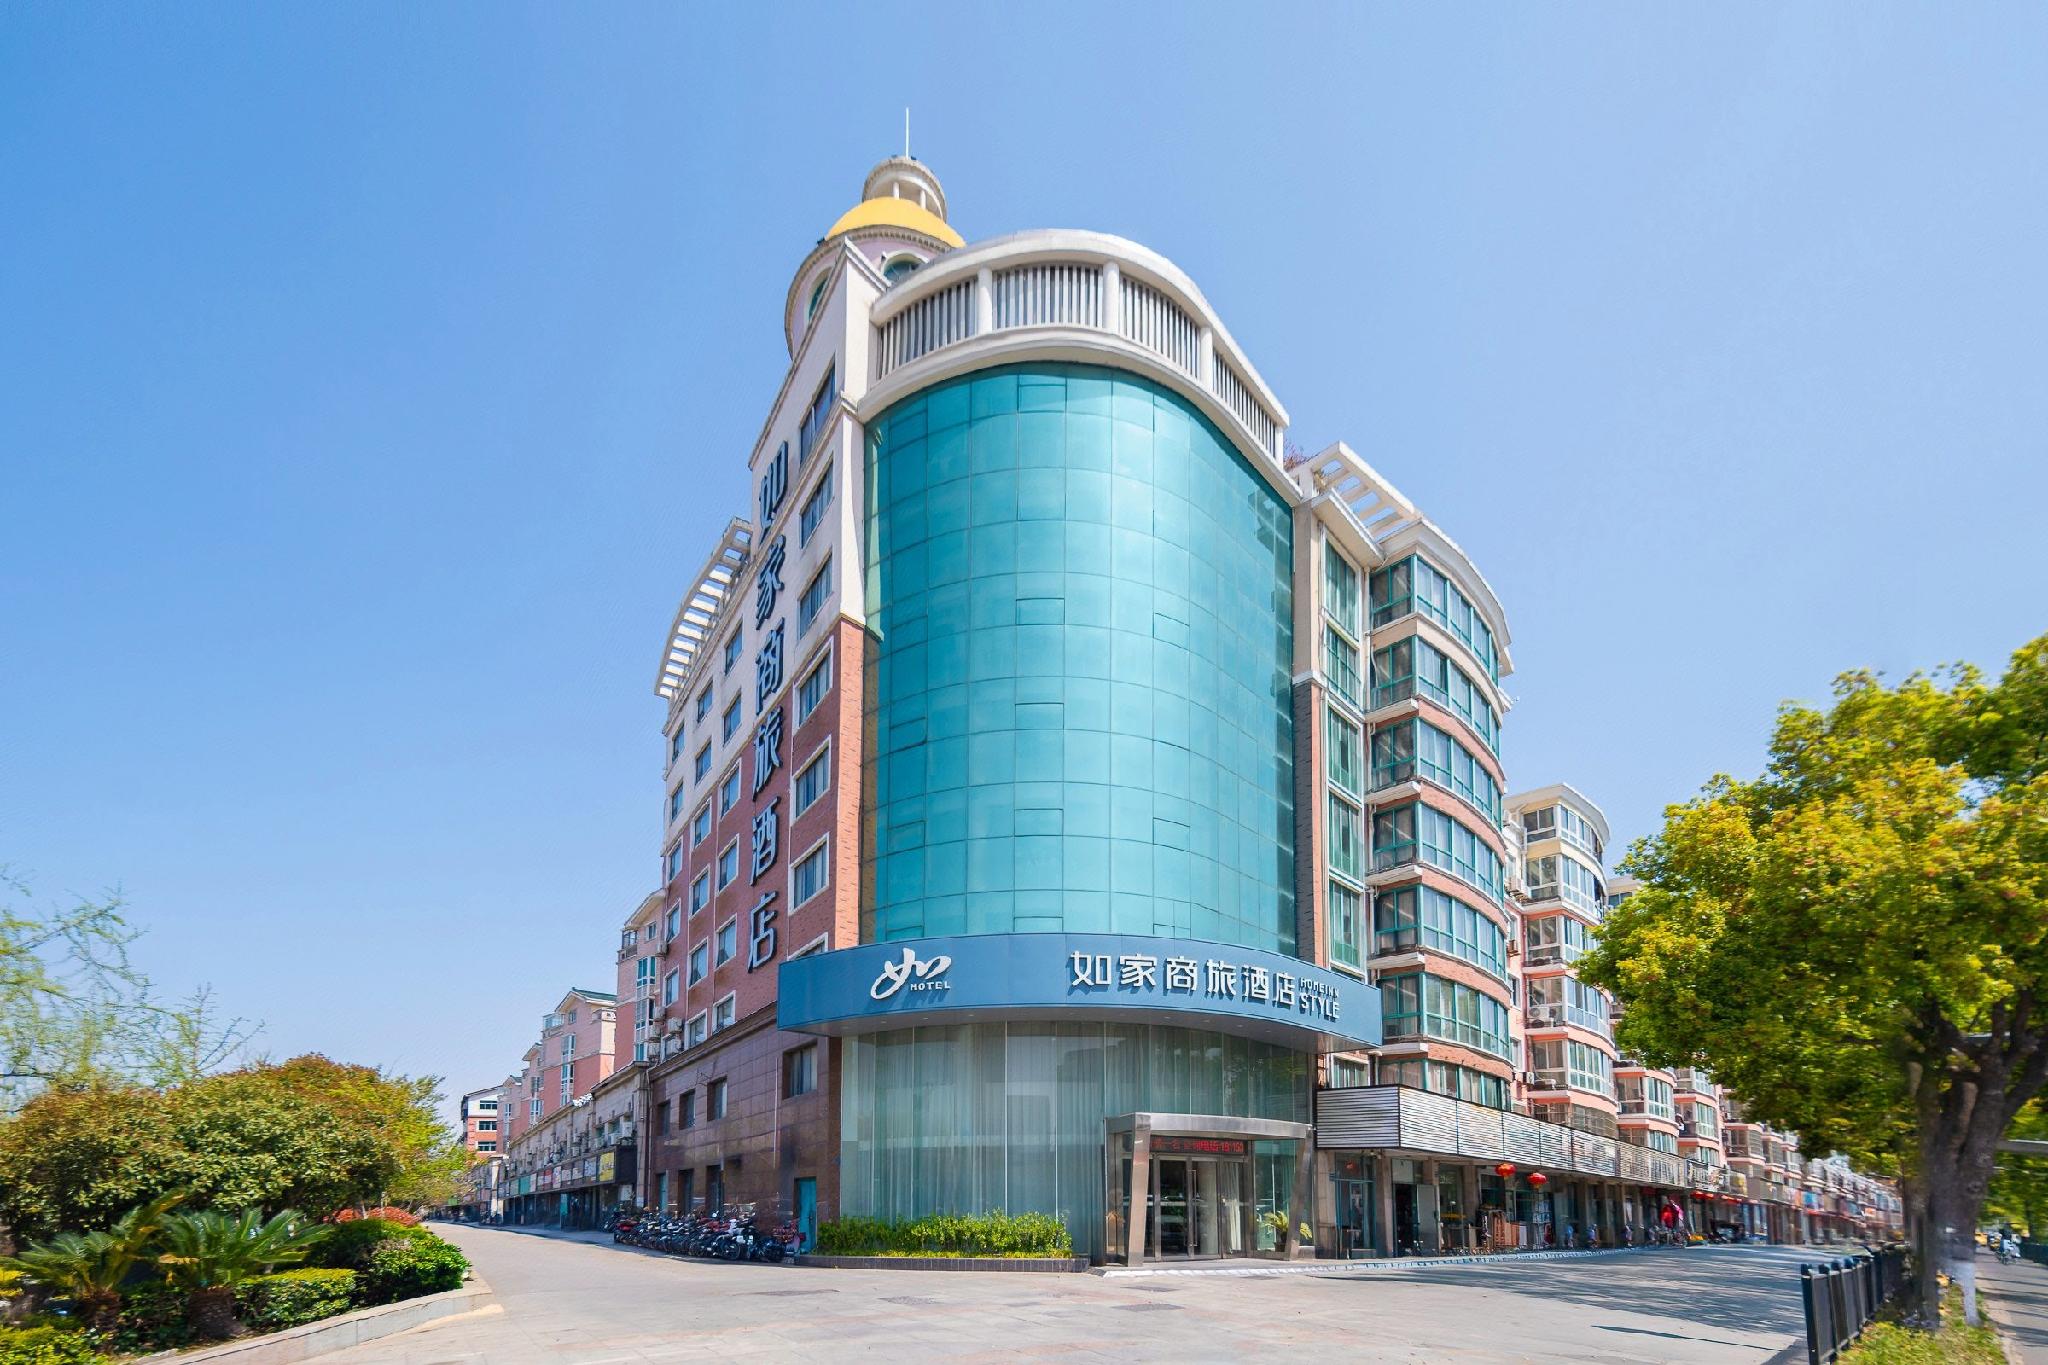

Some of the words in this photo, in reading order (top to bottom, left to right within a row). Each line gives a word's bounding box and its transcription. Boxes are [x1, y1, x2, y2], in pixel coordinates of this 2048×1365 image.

[748, 440, 788, 974] 如家商旅酒店
[910, 980, 951, 991] HOTEL
[1070, 950, 1296, 1006] 如家商旅酒店
[1300, 992, 1340, 1020] STYLE
